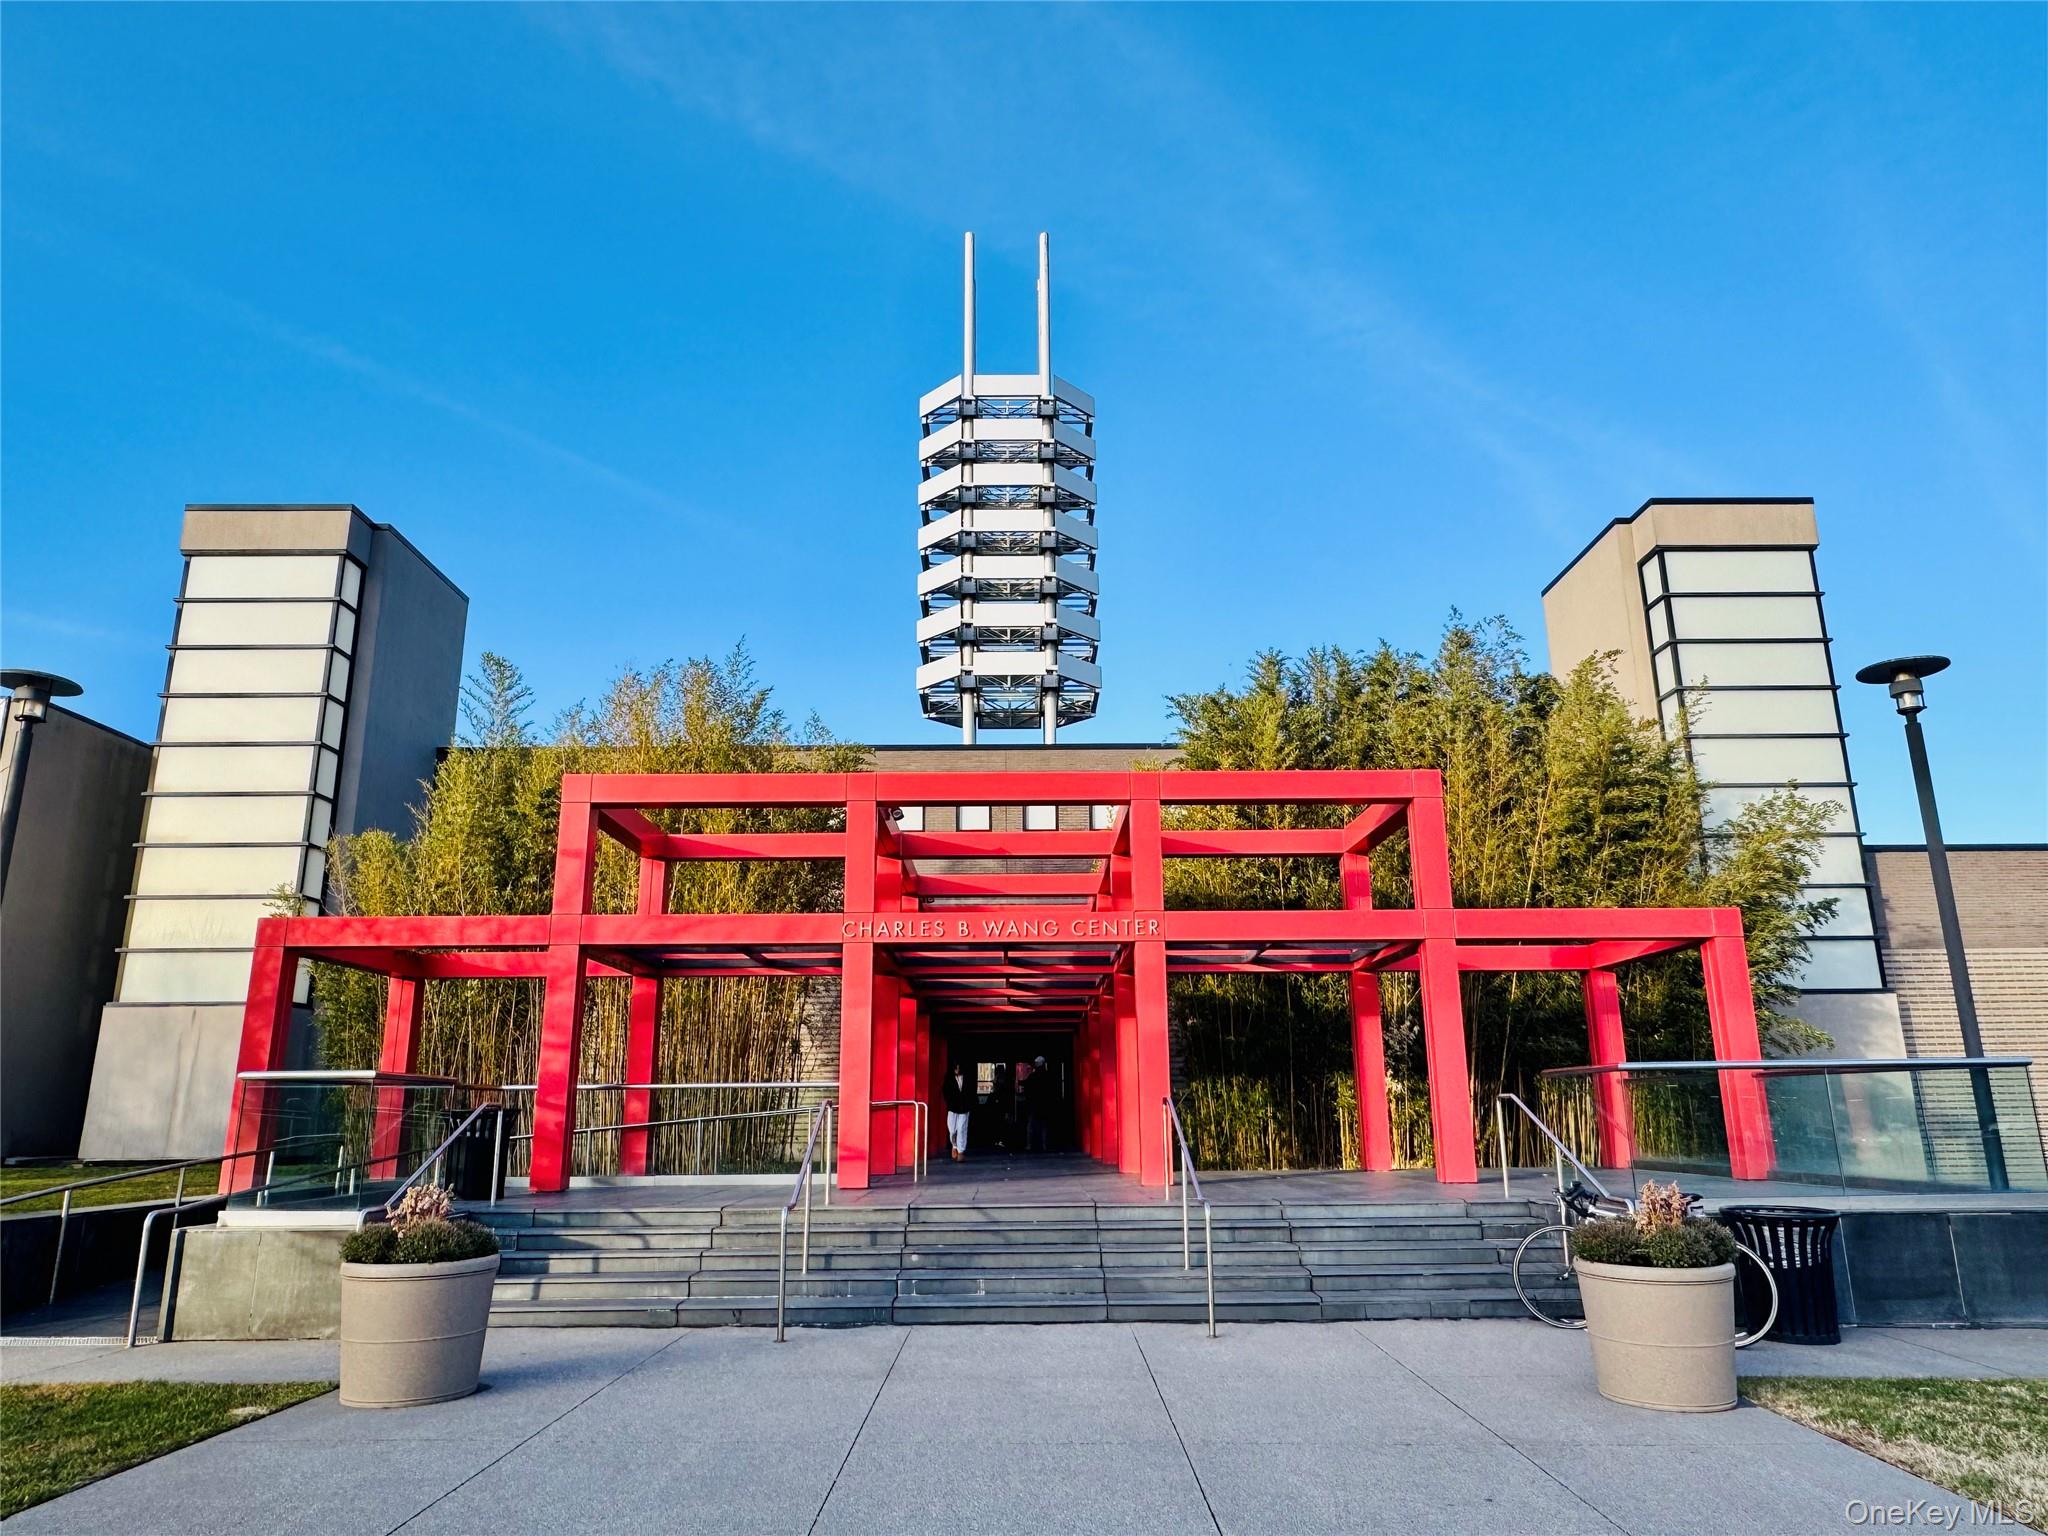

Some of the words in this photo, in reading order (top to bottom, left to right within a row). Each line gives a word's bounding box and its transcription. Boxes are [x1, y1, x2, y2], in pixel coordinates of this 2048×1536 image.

[842, 920, 945, 938] CHARLES
[958, 920, 976, 939] B.
[983, 919, 1060, 937] WANG
[1071, 918, 1161, 936] CENTER
